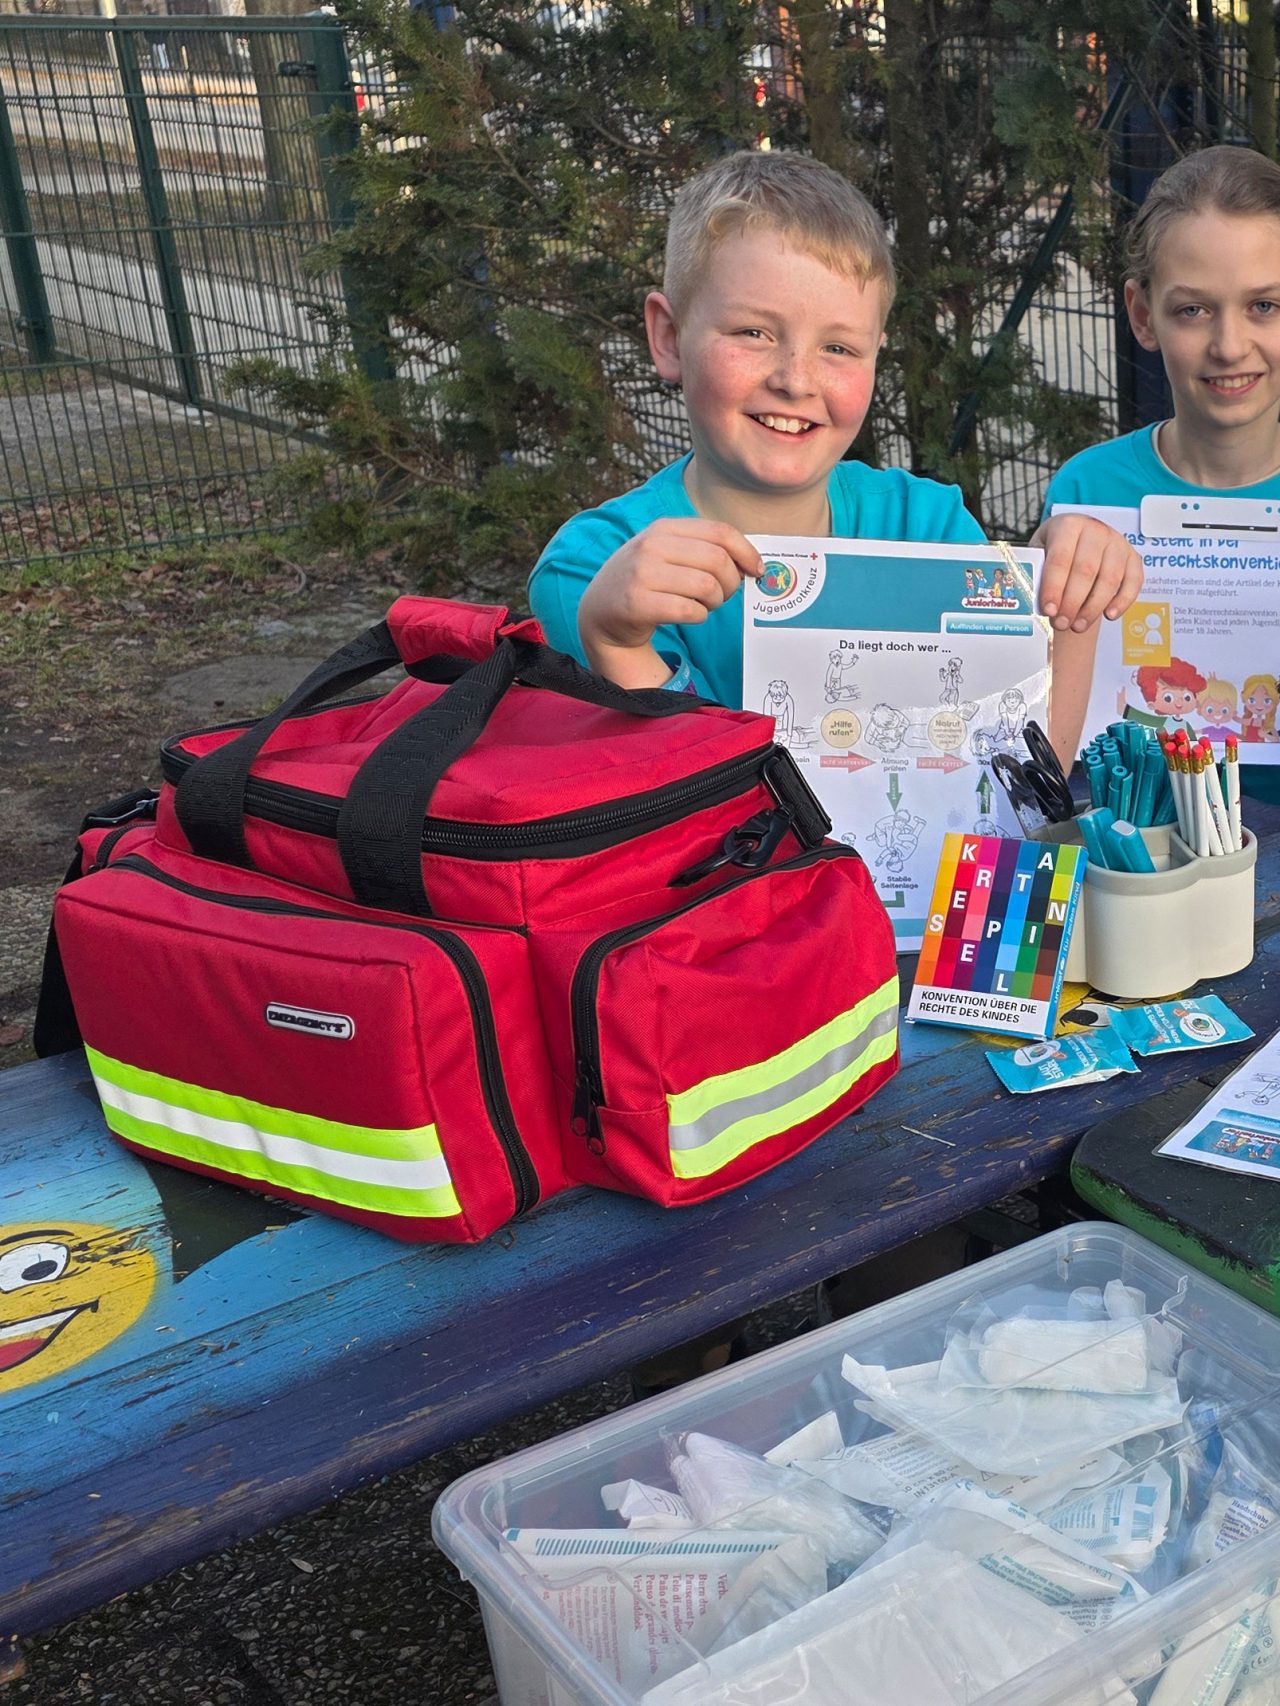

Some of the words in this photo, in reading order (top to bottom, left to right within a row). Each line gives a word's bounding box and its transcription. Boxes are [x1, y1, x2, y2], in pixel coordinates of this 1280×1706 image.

[1125, 534, 1146, 545] as
[1146, 578, 1179, 586] nächsten
[1181, 578, 1204, 586] Seiten
[1205, 578, 1221, 586] sind
[1236, 579, 1261, 587] Artikel
[753, 567, 818, 615] Jugendrotkreuz
[1174, 607, 1186, 615] Die
[1188, 607, 1278, 617] Kinderrechtskonvention
[1004, 624, 1030, 632] Person
[1194, 617, 1212, 625] Kind
[1213, 618, 1228, 626] und
[1174, 627, 1195, 635] unter
[839, 639, 855, 650] Da
[858, 640, 883, 652] liegt
[886, 641, 915, 652] doch
[917, 643, 939, 653] wer
[881, 757, 909, 767] Atmung
[962, 843, 978, 861] K
[1037, 852, 1054, 871] A
[880, 882, 919, 890] Seitenlage
[887, 875, 912, 883] Stabile
[976, 869, 992, 888] R
[1017, 873, 1031, 892] T
[952, 890, 967, 909] E
[1048, 902, 1067, 921] N
[929, 914, 944, 932] S
[986, 920, 1001, 938] P
[1029, 925, 1037, 944] I
[960, 943, 975, 963] E
[996, 973, 1009, 992] L
[921, 990, 988, 1007] KONVENTION
[990, 998, 1018, 1011] ÜBER
[1020, 1003, 1037, 1014] DIE
[919, 1002, 958, 1014] RECHTE
[959, 1007, 979, 1018] DES
[981, 1010, 1020, 1023] KINDES
